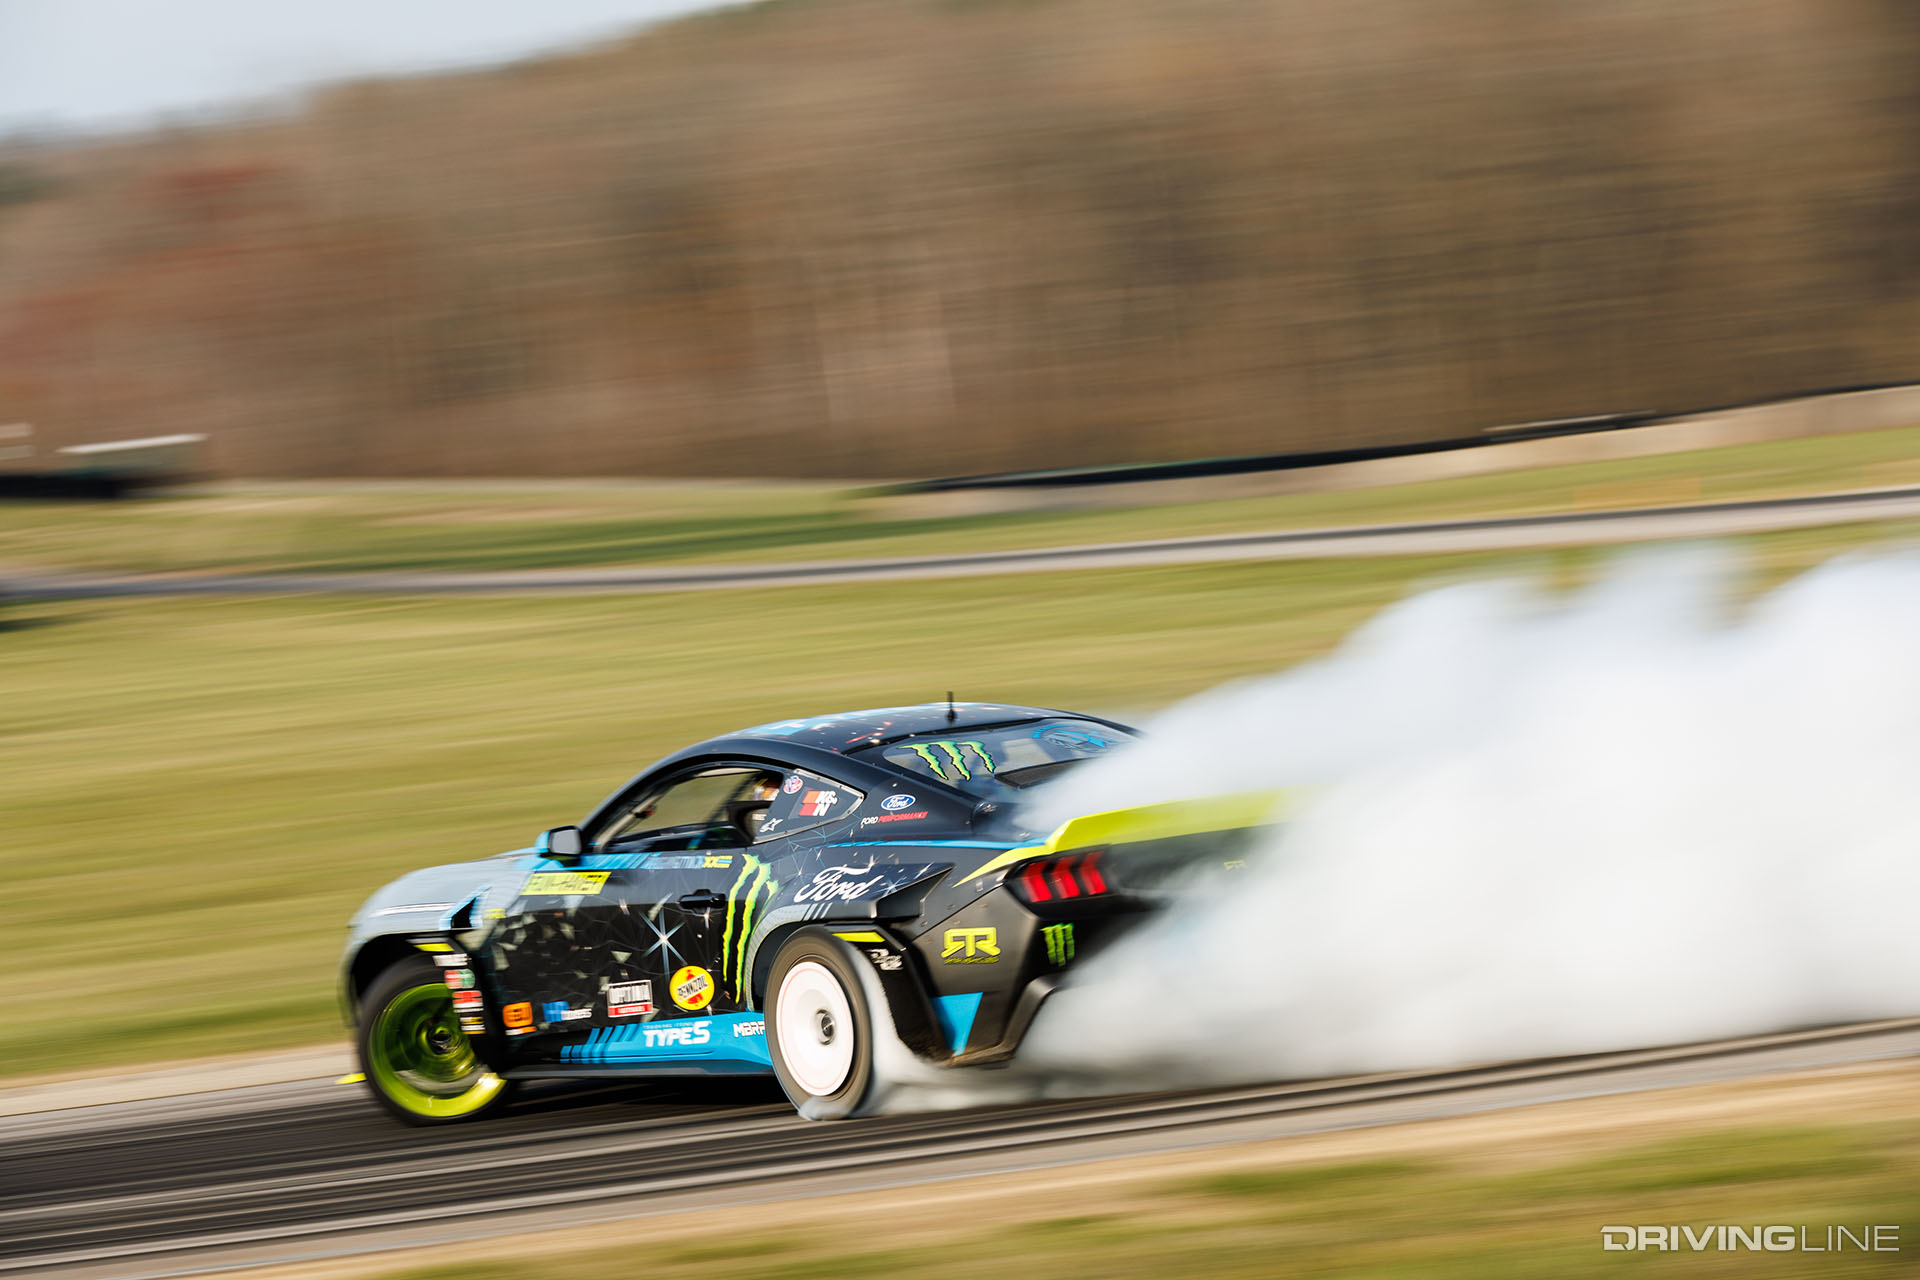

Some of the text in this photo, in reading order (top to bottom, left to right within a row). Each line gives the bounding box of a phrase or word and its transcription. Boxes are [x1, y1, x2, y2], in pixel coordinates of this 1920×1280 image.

[887, 796, 910, 808] Ford
[860, 816, 879, 825] FORD
[794, 865, 884, 903] Ford
